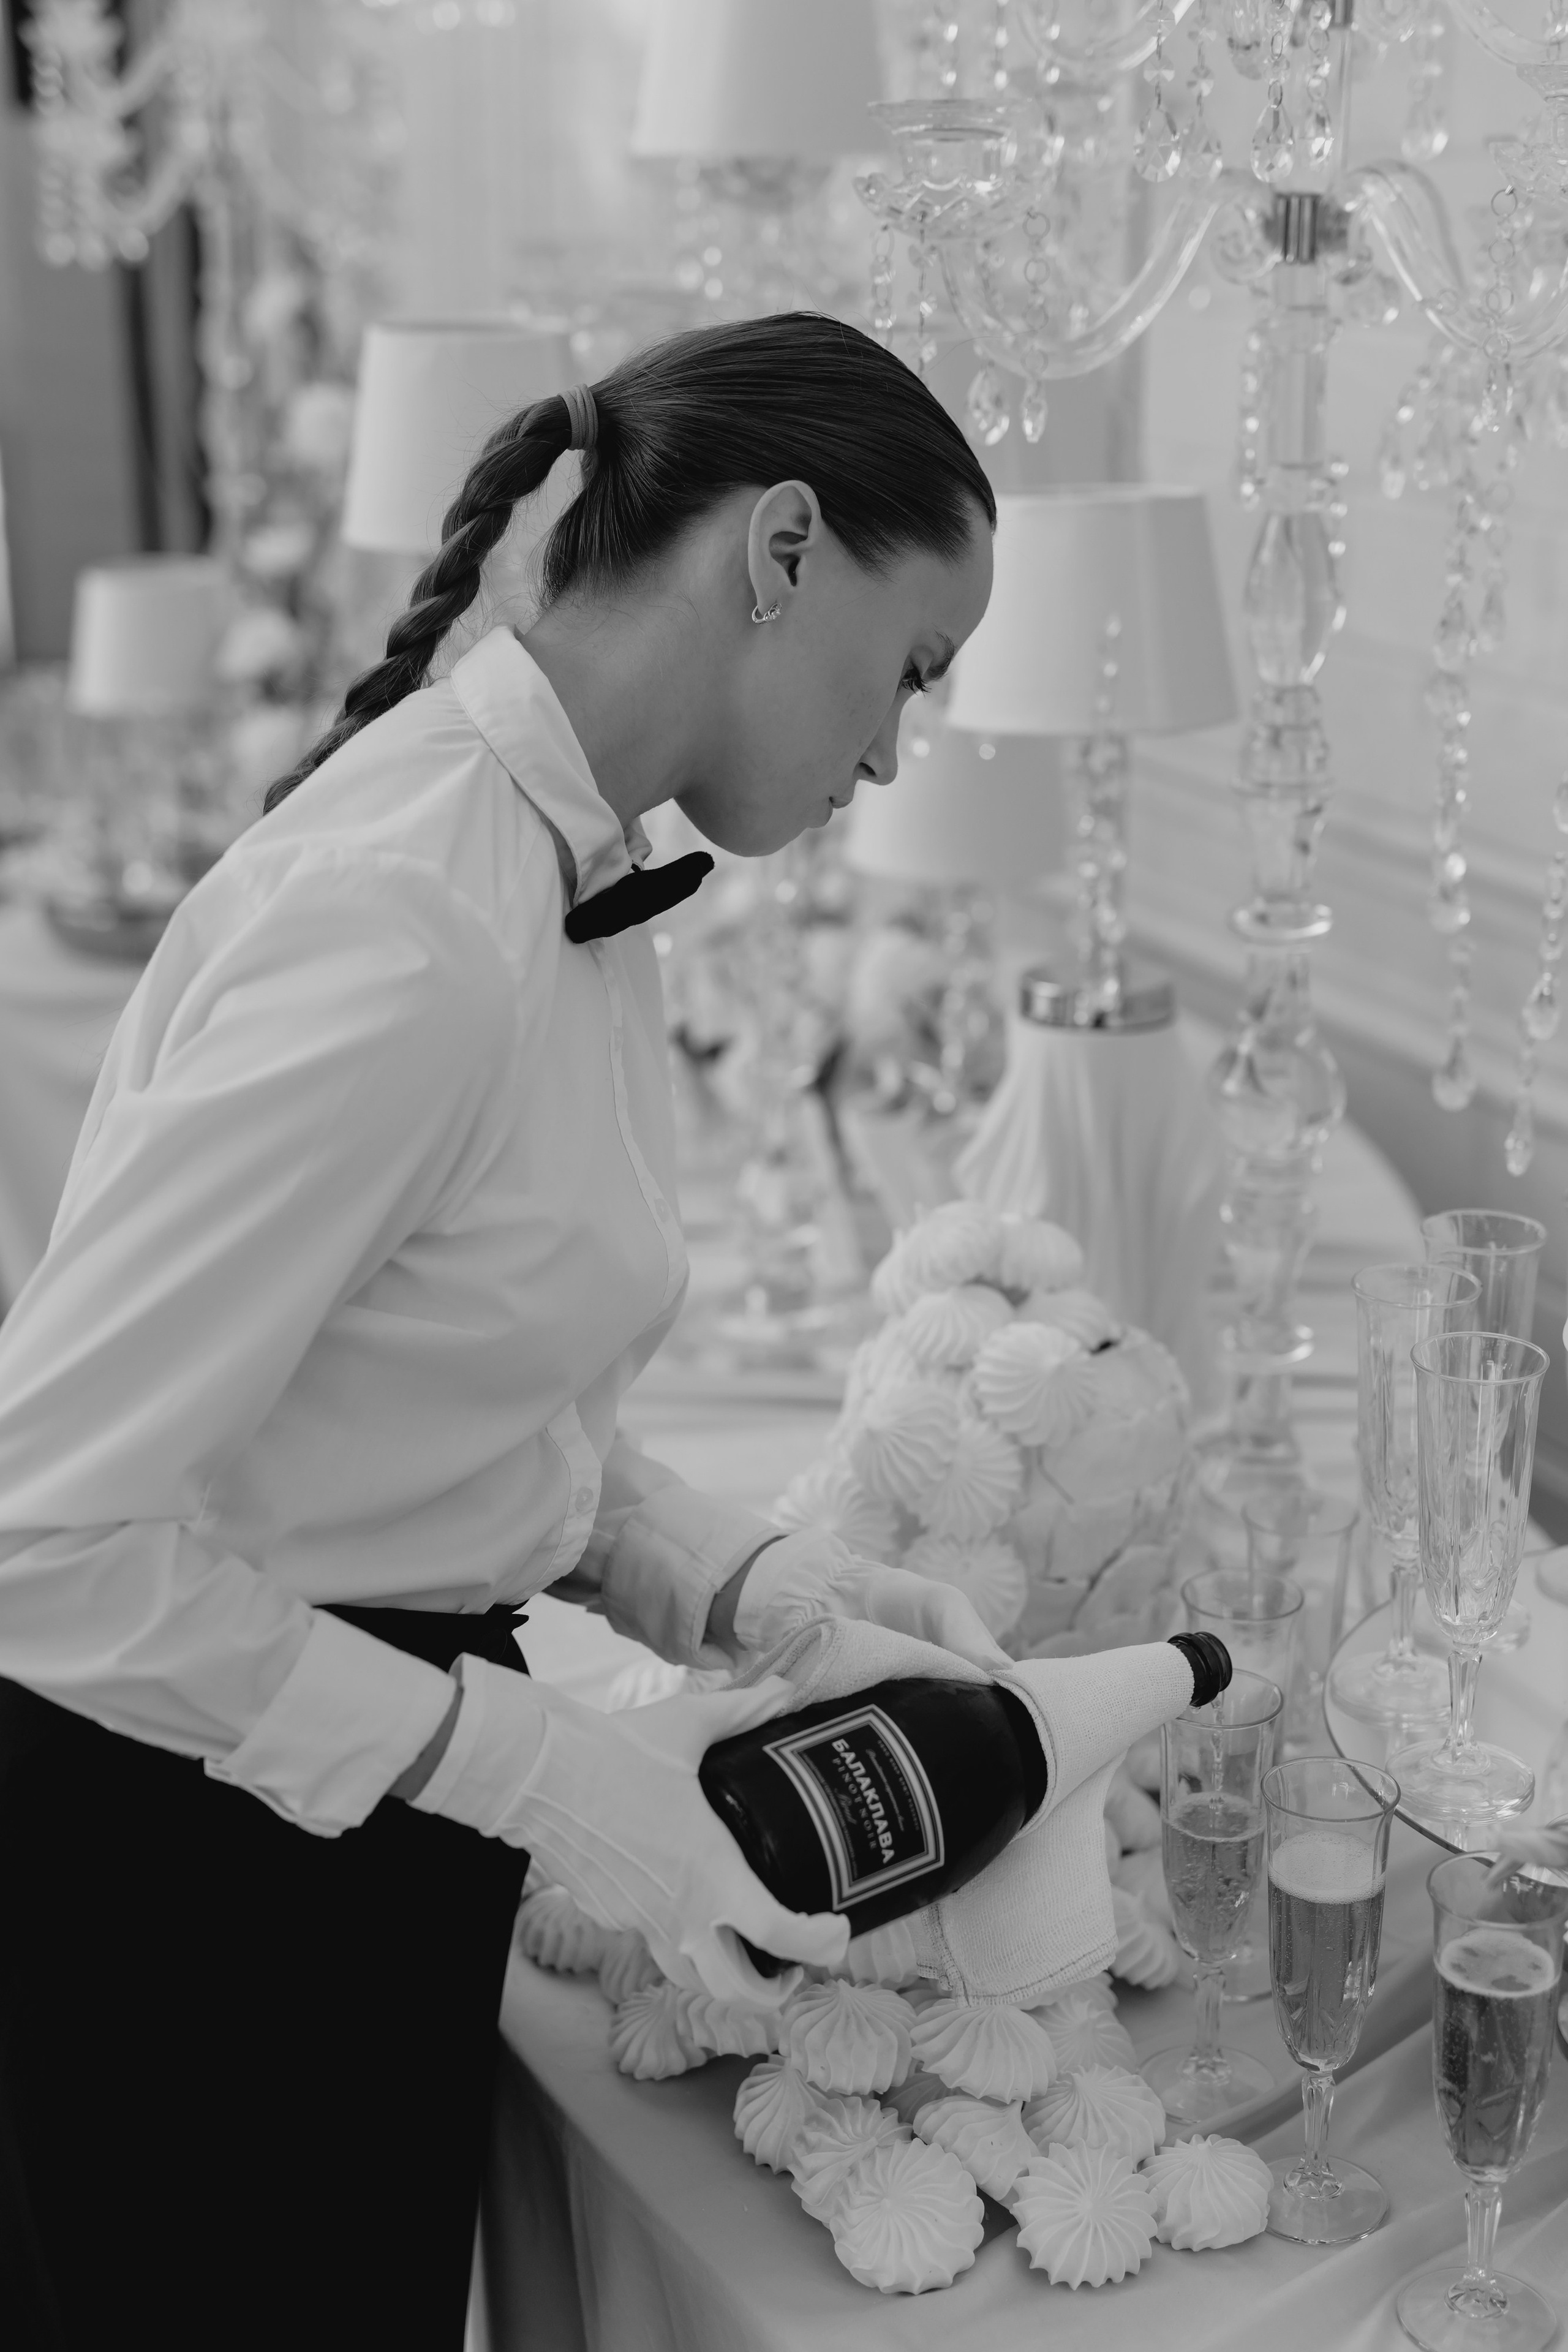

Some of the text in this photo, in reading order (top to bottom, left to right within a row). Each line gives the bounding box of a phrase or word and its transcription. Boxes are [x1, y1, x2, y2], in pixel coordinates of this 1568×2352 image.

[832, 1738, 895, 1864] БАЛАКЛАВА
[832, 1757, 877, 1850] PINOT NOIR
